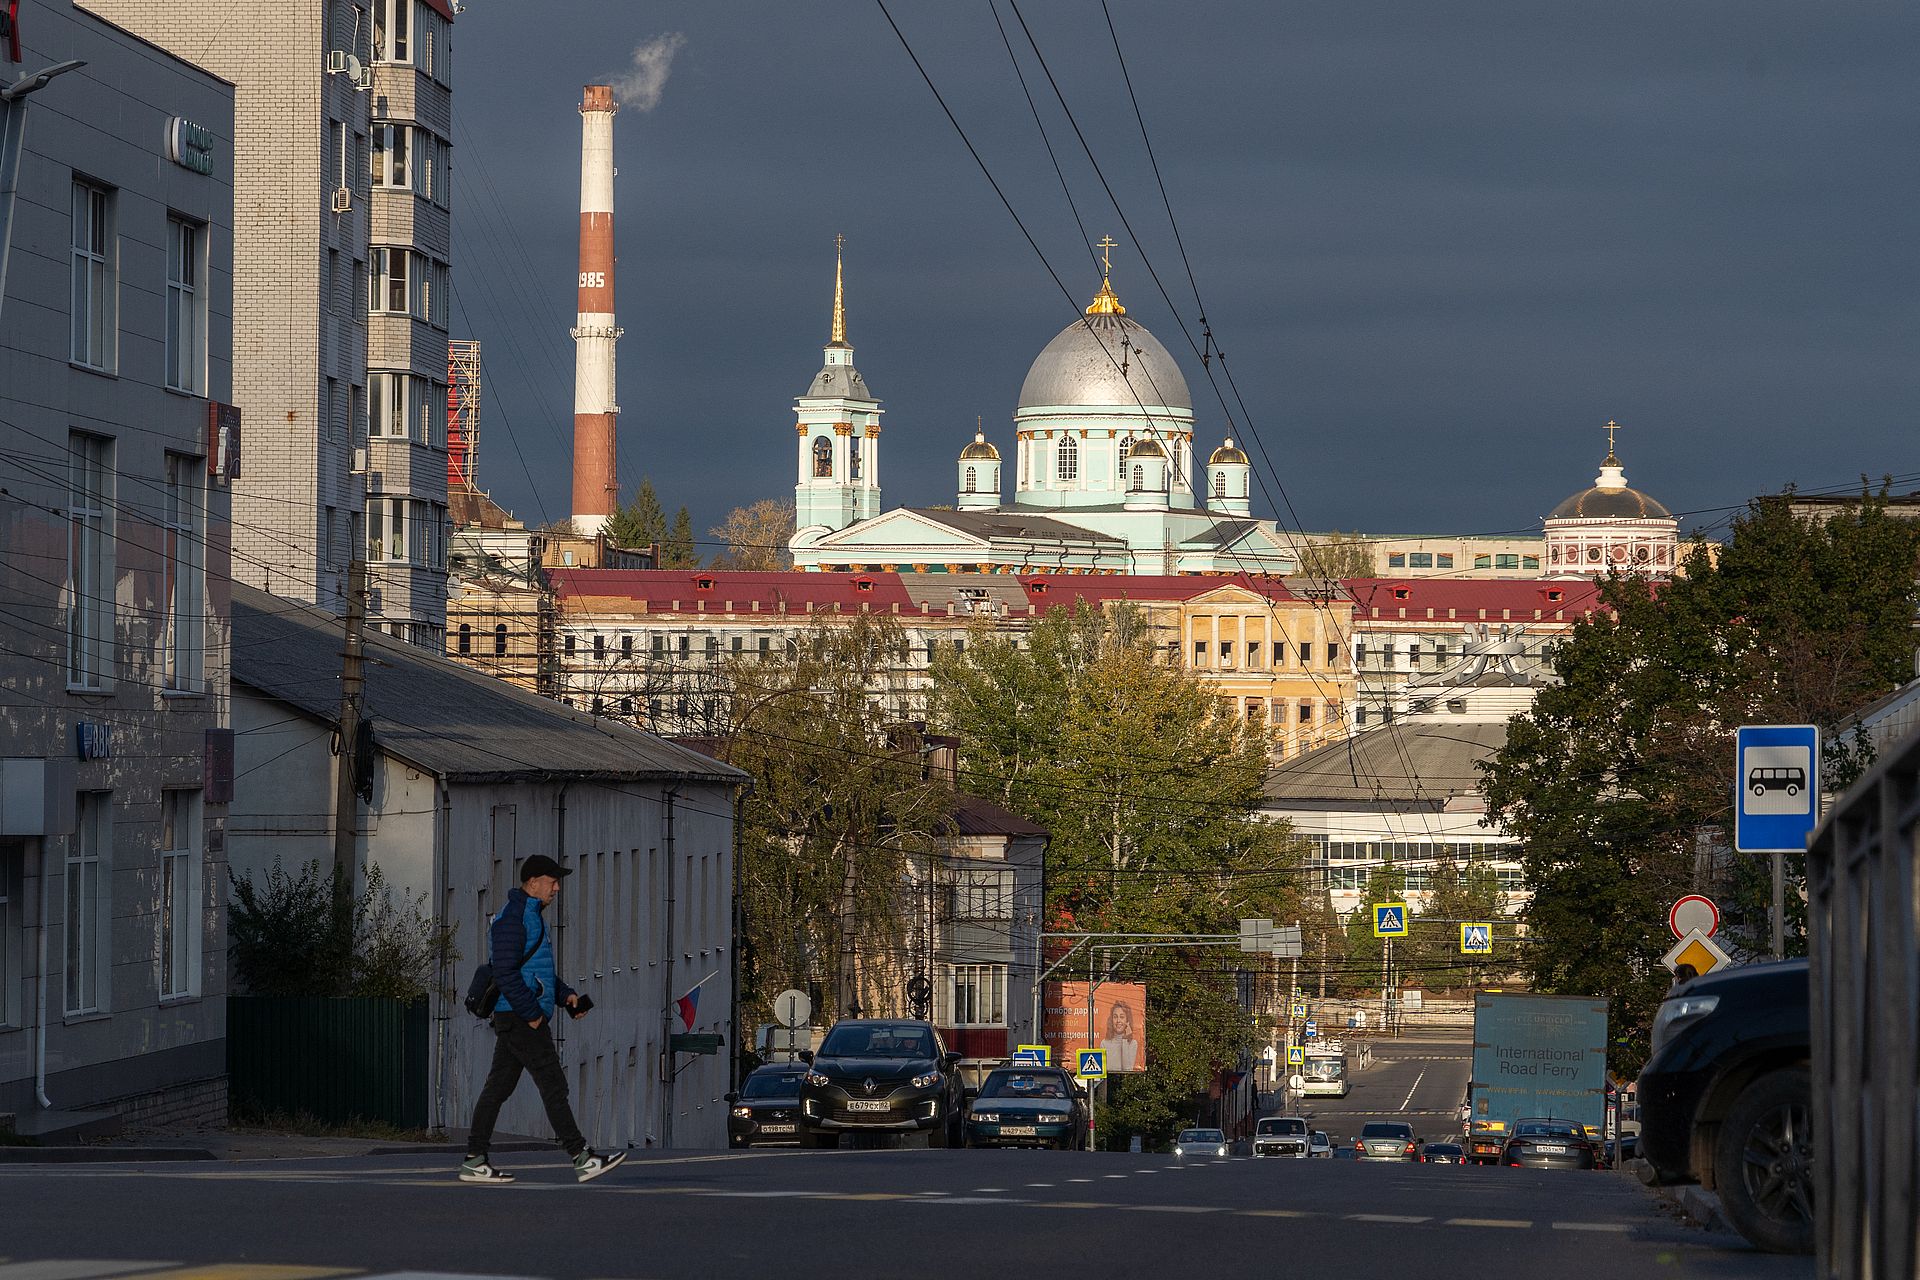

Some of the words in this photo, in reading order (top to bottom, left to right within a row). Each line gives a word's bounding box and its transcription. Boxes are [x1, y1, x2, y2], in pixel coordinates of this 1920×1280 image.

[579, 272, 605, 288] 1985
[1058, 1032, 1100, 1040] пациентм
[1496, 1045, 1584, 1061] International
[1500, 1061, 1537, 1075] Road
[1543, 1063, 1579, 1081] Ferry
